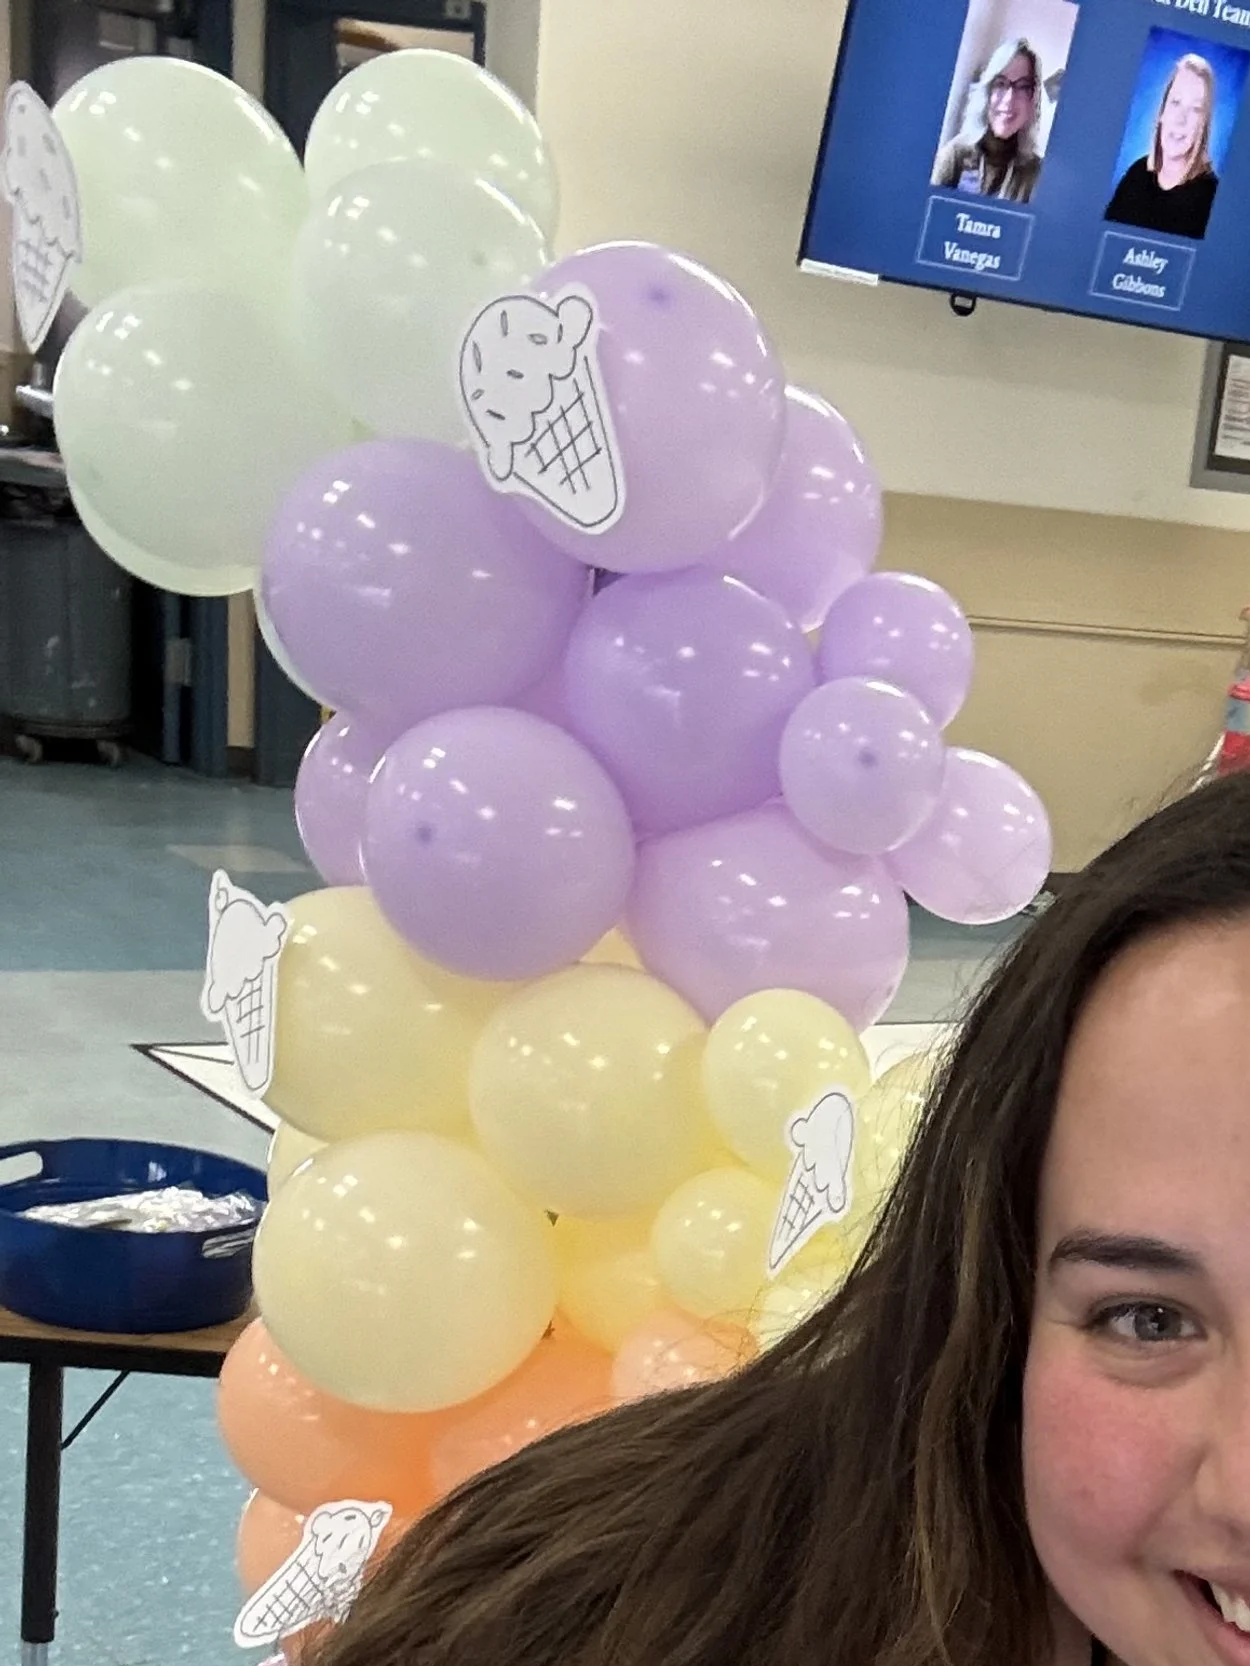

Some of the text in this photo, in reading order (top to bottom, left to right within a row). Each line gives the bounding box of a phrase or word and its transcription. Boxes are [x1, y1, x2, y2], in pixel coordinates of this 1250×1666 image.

[956, 212, 1001, 239] Tamra
[944, 241, 1001, 271] Vanegas
[1123, 247, 1169, 275] Ashley
[1112, 273, 1166, 298] Gibbons
